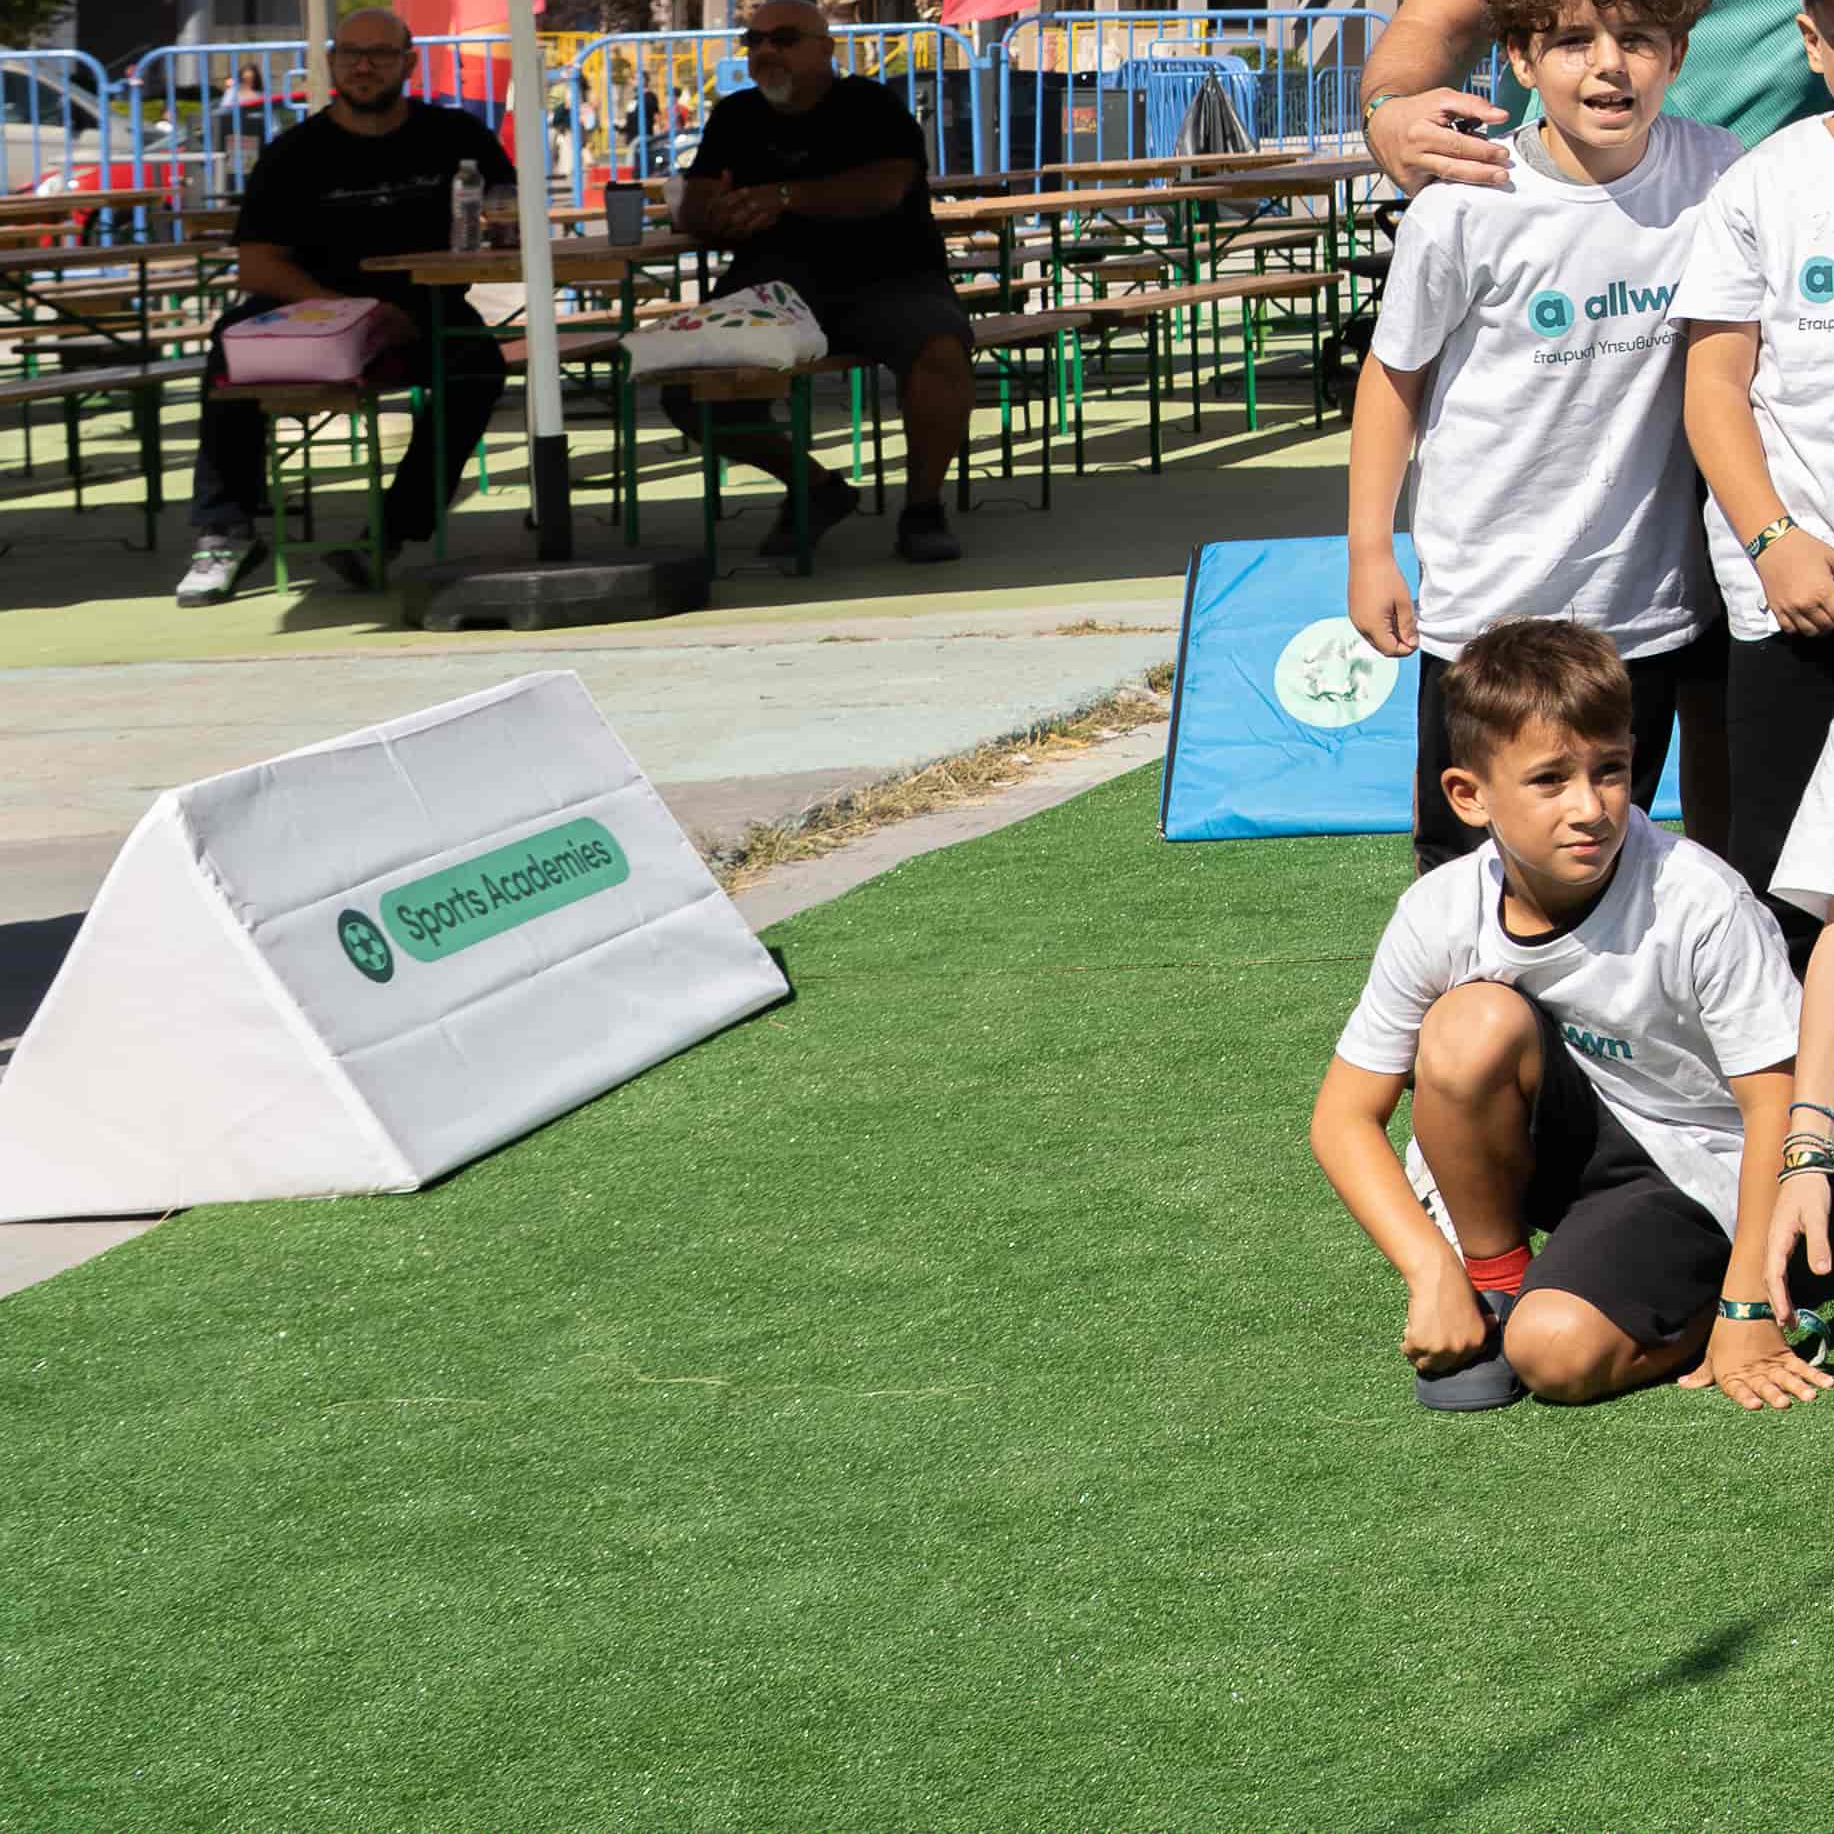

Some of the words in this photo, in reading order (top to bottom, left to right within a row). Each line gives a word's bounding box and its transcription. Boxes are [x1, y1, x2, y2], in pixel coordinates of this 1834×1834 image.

[1584, 280, 1680, 320] allwy
[396, 887, 489, 948] Sports
[481, 839, 613, 910] Academies
